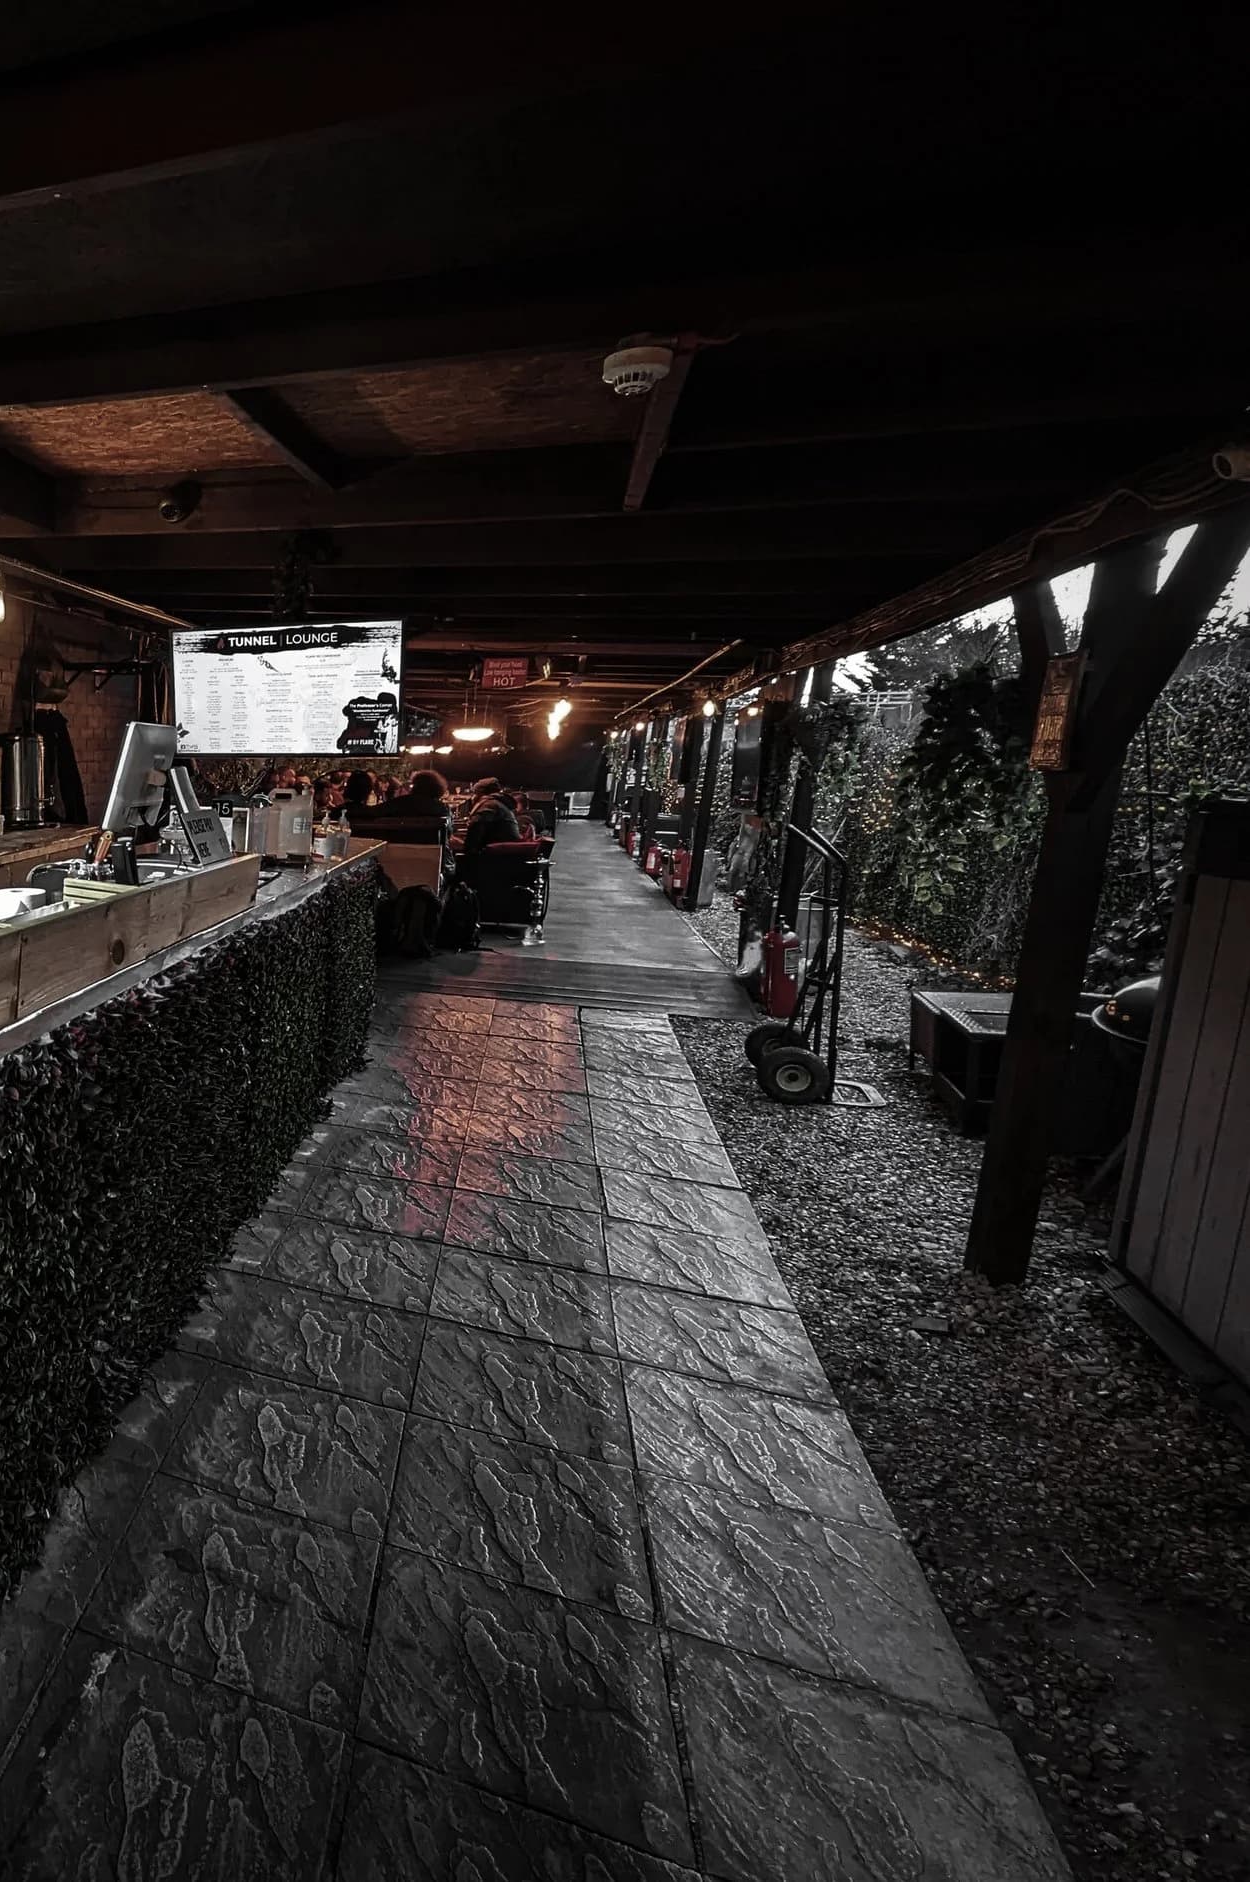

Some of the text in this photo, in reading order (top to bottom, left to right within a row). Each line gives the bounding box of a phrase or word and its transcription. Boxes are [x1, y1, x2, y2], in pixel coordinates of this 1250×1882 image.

[228, 632, 338, 647] TUNNEL LOUNGE
[493, 677, 516, 686] HOT
[215, 802, 230, 815] 15
